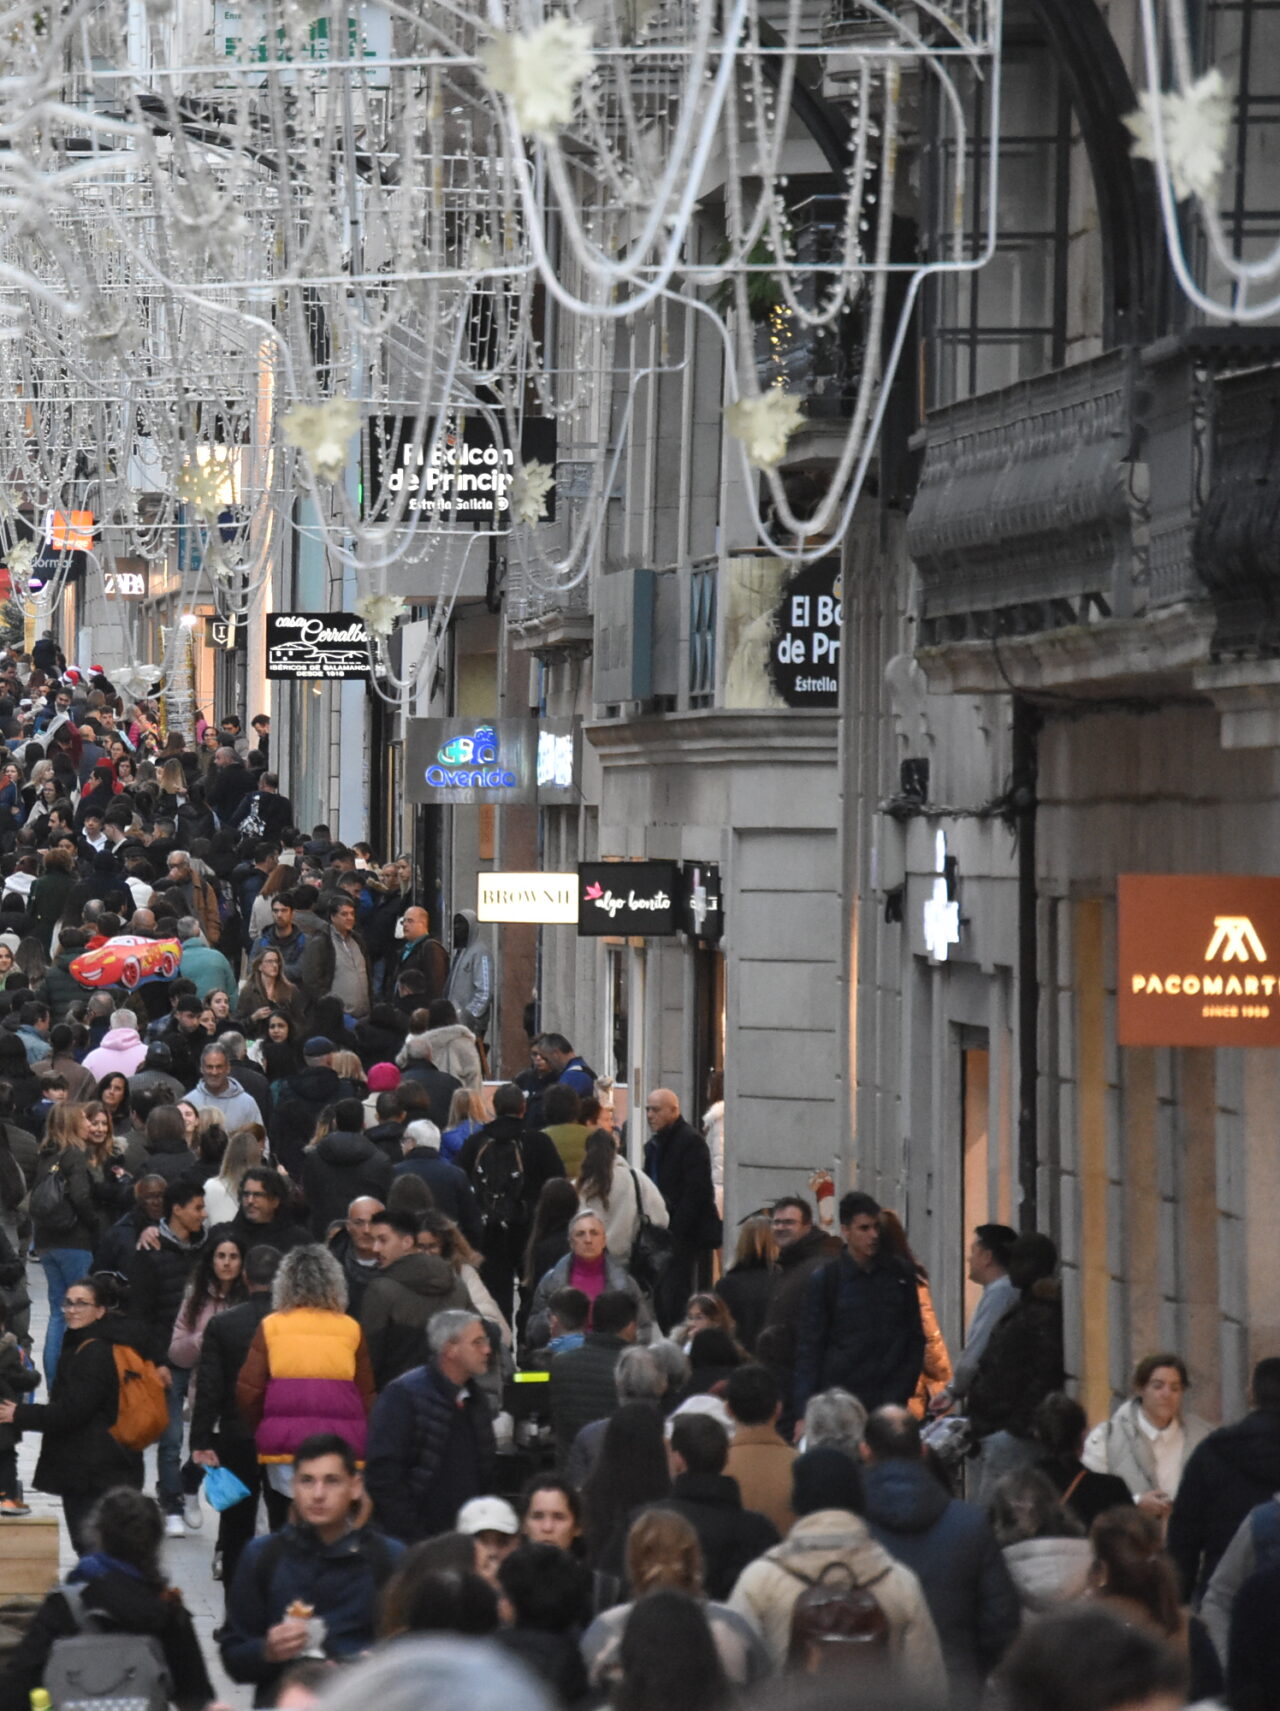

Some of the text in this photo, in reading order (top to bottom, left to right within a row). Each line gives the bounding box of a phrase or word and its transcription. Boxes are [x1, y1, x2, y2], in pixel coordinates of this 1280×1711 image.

[792, 595, 809, 628] El
[778, 632, 805, 664] de
[795, 675, 837, 692] Estrella
[595, 890, 625, 918] algo
[628, 890, 671, 911] bonito
[1131, 974, 1280, 996] PACOMART
[1201, 1004, 1239, 1018] SINCE
